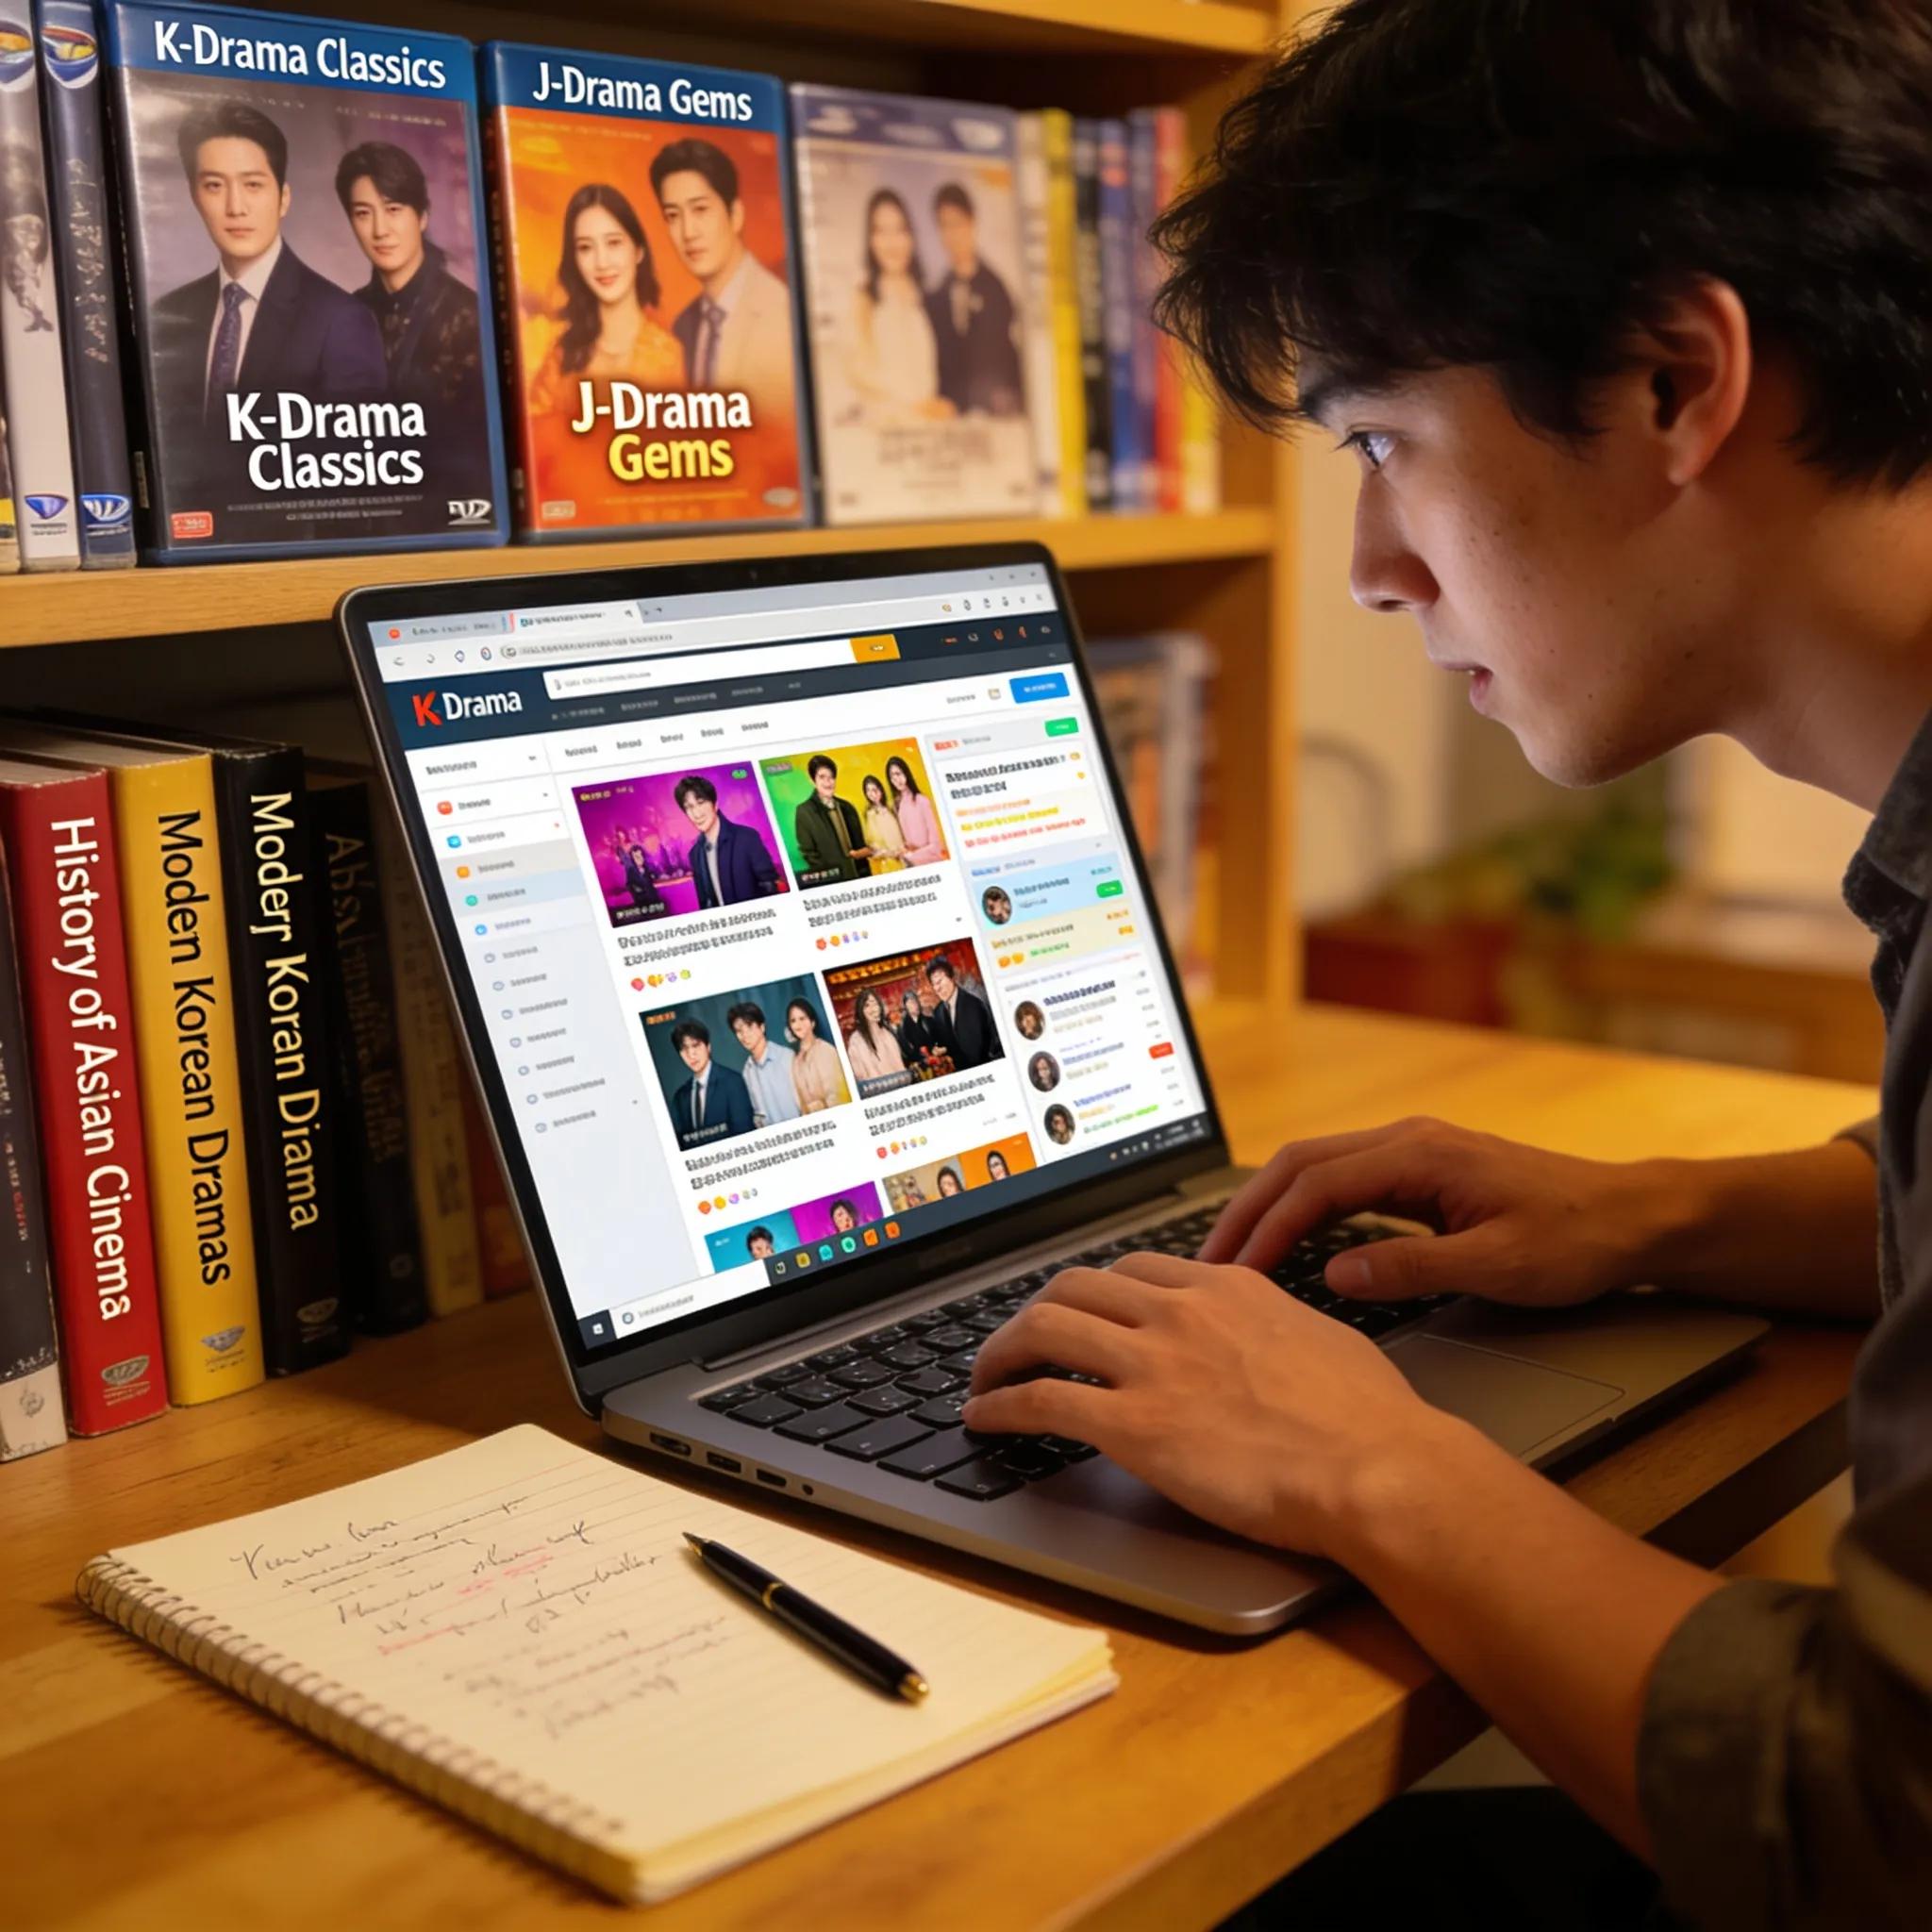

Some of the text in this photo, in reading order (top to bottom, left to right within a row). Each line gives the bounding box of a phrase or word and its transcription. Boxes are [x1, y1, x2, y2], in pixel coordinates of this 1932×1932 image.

[154, 20, 446, 89] K-Drama Classics
[532, 61, 753, 122] J-Drama Gems
[226, 392, 426, 441] K-Drama
[572, 380, 752, 432] J-Drama
[248, 439, 424, 491] Classics
[608, 434, 734, 480] Gems
[441, 691, 523, 720] Drama
[265, 953, 309, 1080] Koran
[51, 816, 132, 1321] History of Asian Cinema
[158, 809, 231, 1286] Moden Korean Dramas
